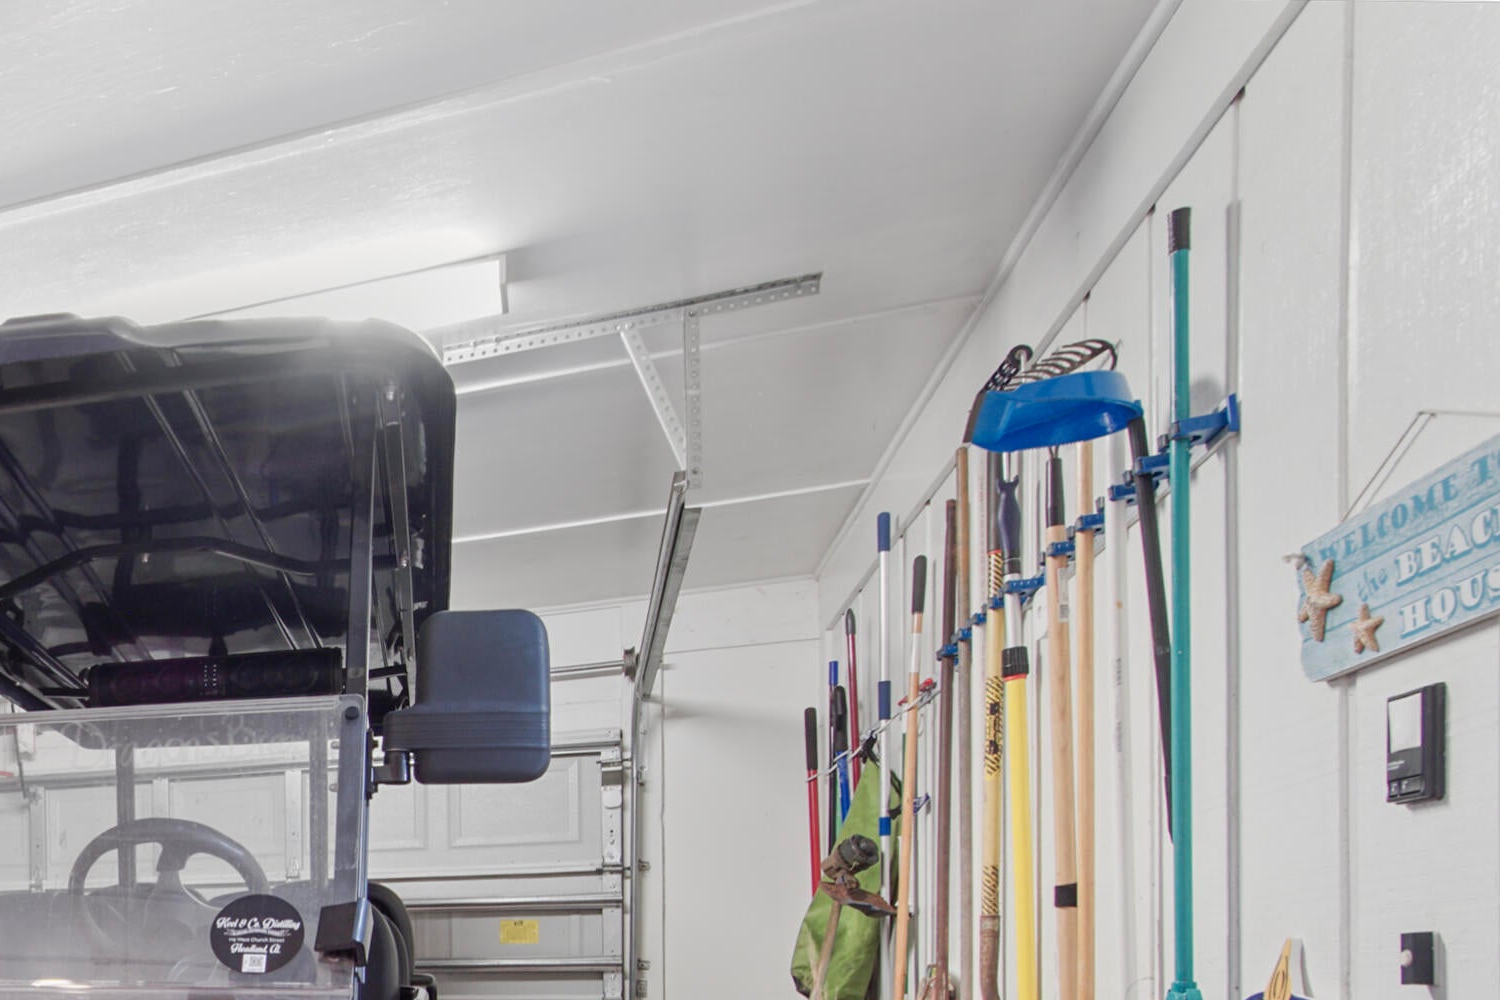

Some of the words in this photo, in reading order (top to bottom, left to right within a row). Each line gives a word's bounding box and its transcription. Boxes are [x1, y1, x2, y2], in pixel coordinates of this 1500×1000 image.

[1318, 472, 1458, 561] WELCOME
[1470, 451, 1500, 488] T
[1357, 565, 1388, 601] the
